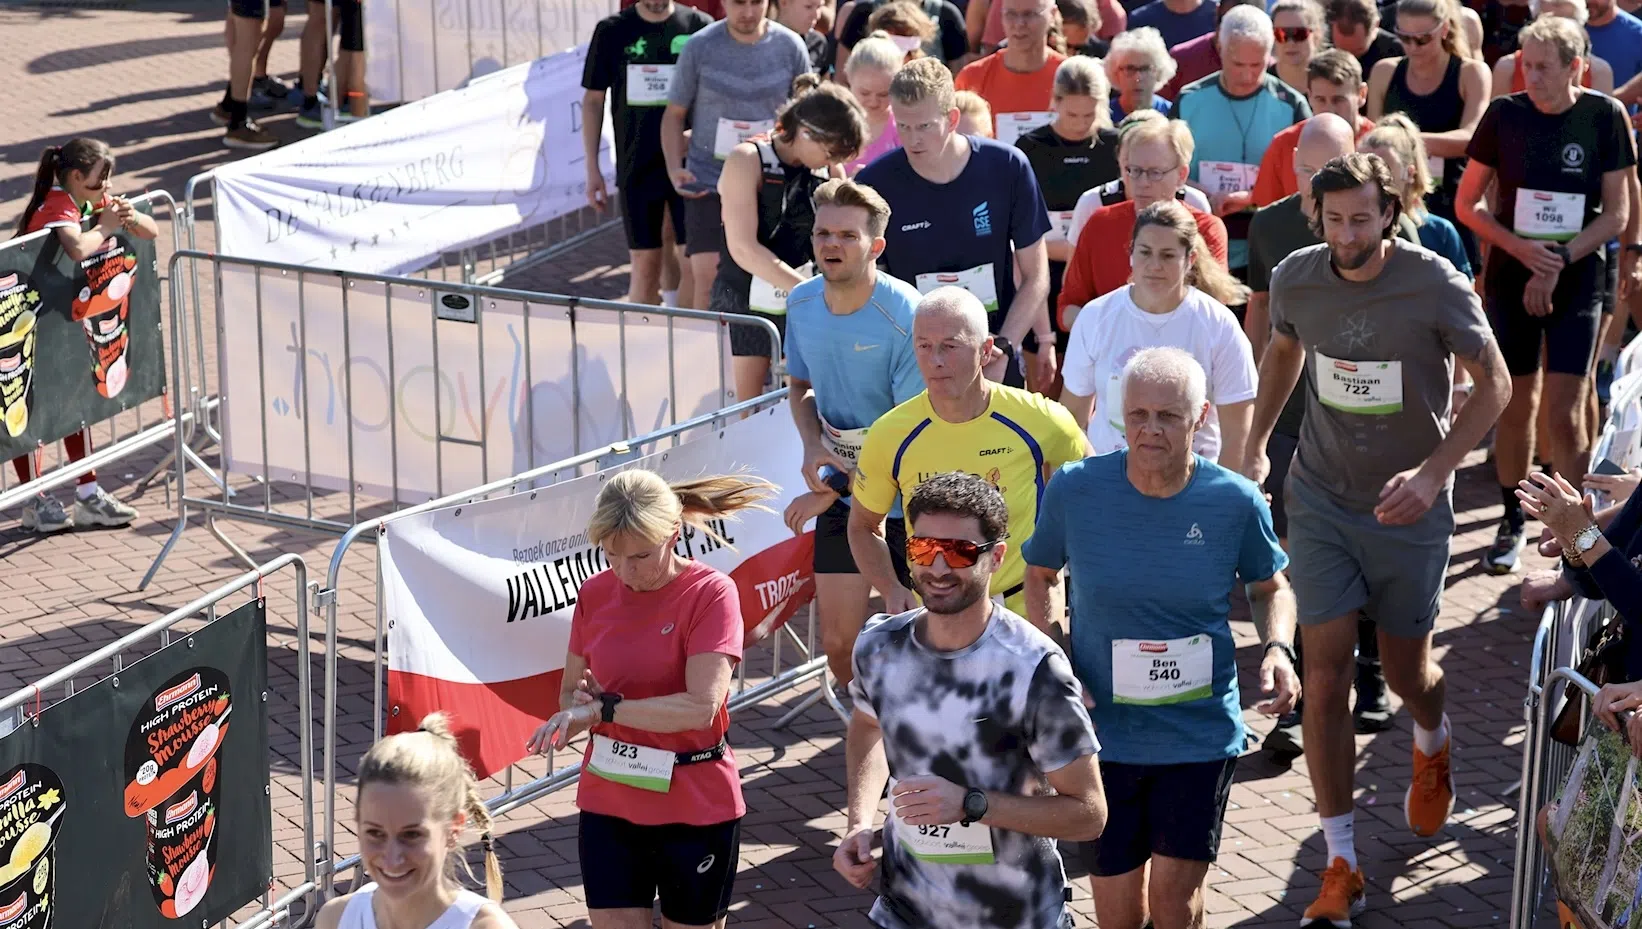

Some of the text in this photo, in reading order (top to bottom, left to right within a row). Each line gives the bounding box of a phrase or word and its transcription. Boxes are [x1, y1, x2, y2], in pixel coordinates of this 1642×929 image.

[973, 215, 990, 229] CSE
[1535, 212, 1564, 223] 1098
[901, 221, 924, 232] CRAFT
[1333, 372, 1381, 385] Bastiaan
[1343, 383, 1371, 395] 722
[829, 439, 863, 451] miniqu
[979, 447, 1006, 456] CRAFT
[833, 447, 856, 459] 498
[512, 539, 544, 567] Bezoek
[545, 537, 568, 557] onze
[1152, 659, 1177, 668] Ben
[1149, 668, 1181, 681] 540
[157, 677, 197, 706] Ehrmann
[140, 684, 219, 733] HIGH PROTEIN
[147, 699, 216, 755] Strawberry
[154, 714, 213, 767] mousse
[611, 741, 638, 759] 923
[155, 827, 174, 839] HIGH
[176, 797, 210, 834] PROTEIN
[918, 824, 950, 839] 927
